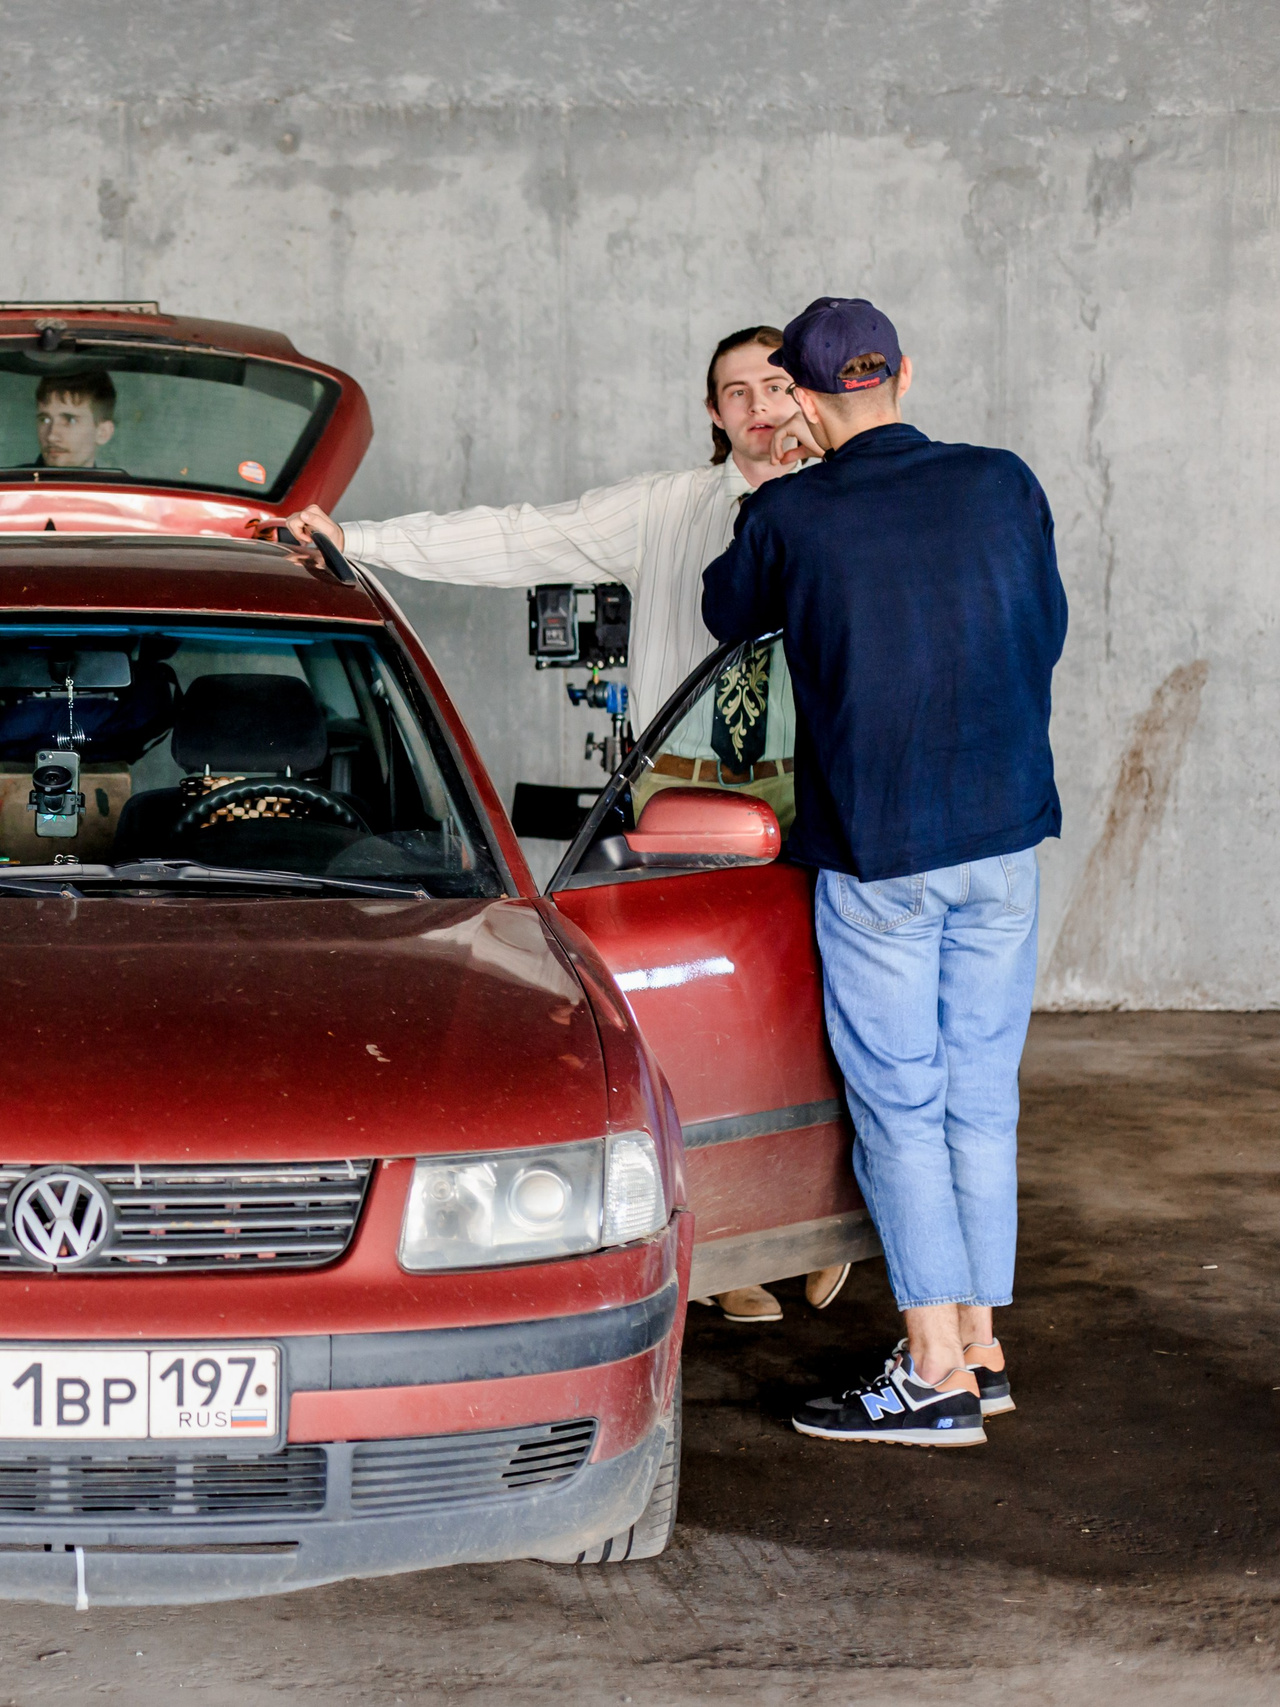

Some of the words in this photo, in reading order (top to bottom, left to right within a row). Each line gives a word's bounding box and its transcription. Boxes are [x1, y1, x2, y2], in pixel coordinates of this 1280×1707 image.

[14, 1174, 108, 1264] VW
[160, 1357, 257, 1407] 197
[178, 1410, 228, 1428] RUS
[861, 1387, 905, 1420] N
[937, 1418, 954, 1429] NB
